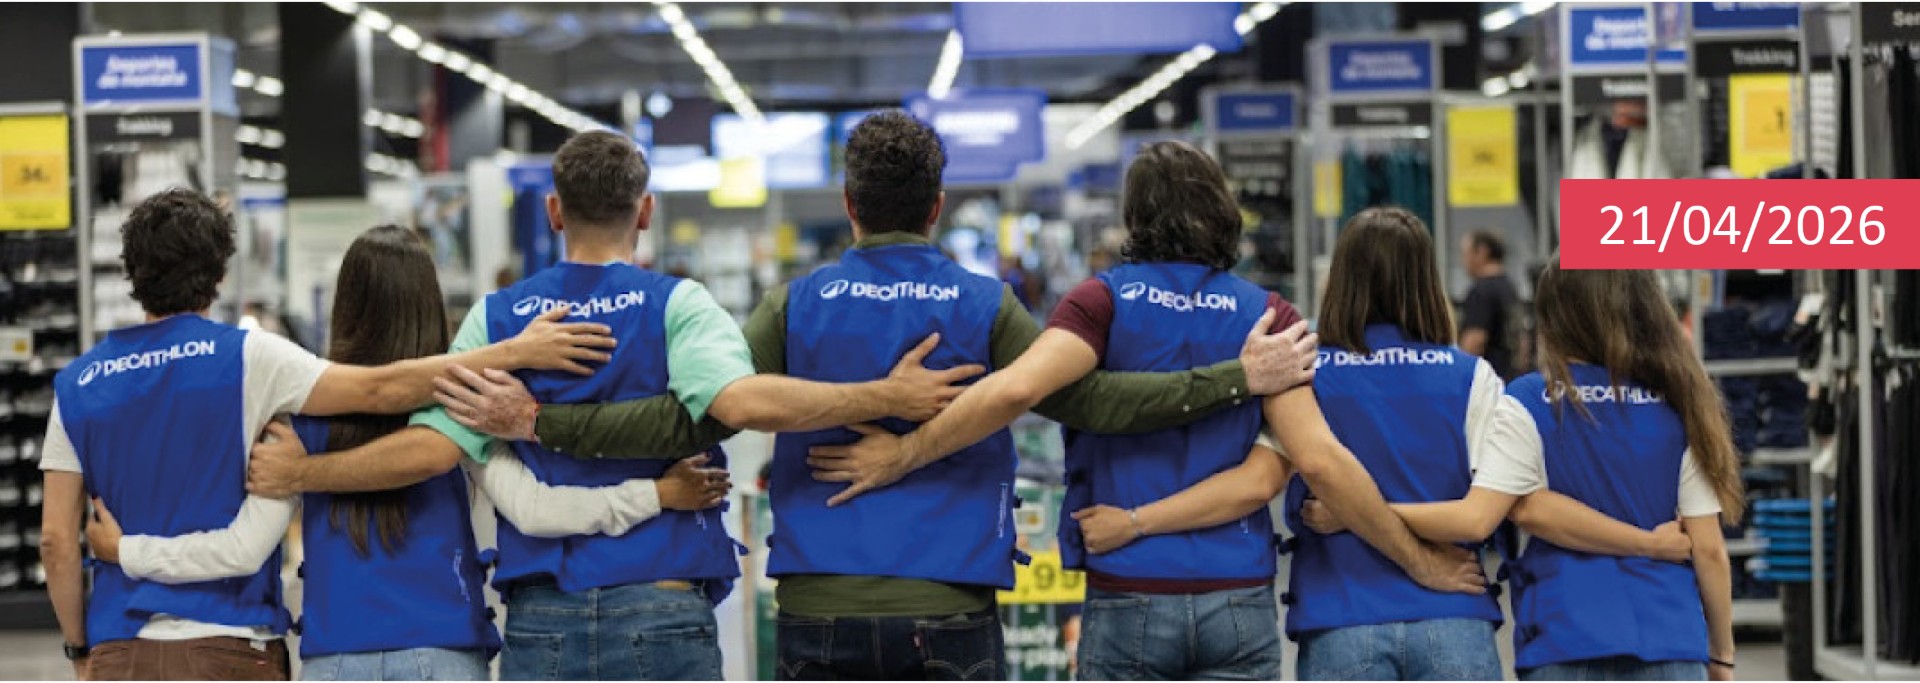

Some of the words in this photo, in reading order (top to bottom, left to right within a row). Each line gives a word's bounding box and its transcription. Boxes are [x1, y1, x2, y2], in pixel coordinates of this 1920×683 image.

[852, 282, 959, 301] DECATHLON
[104, 340, 215, 377] DECATHLON
[1334, 347, 1454, 365] DECATHLON
